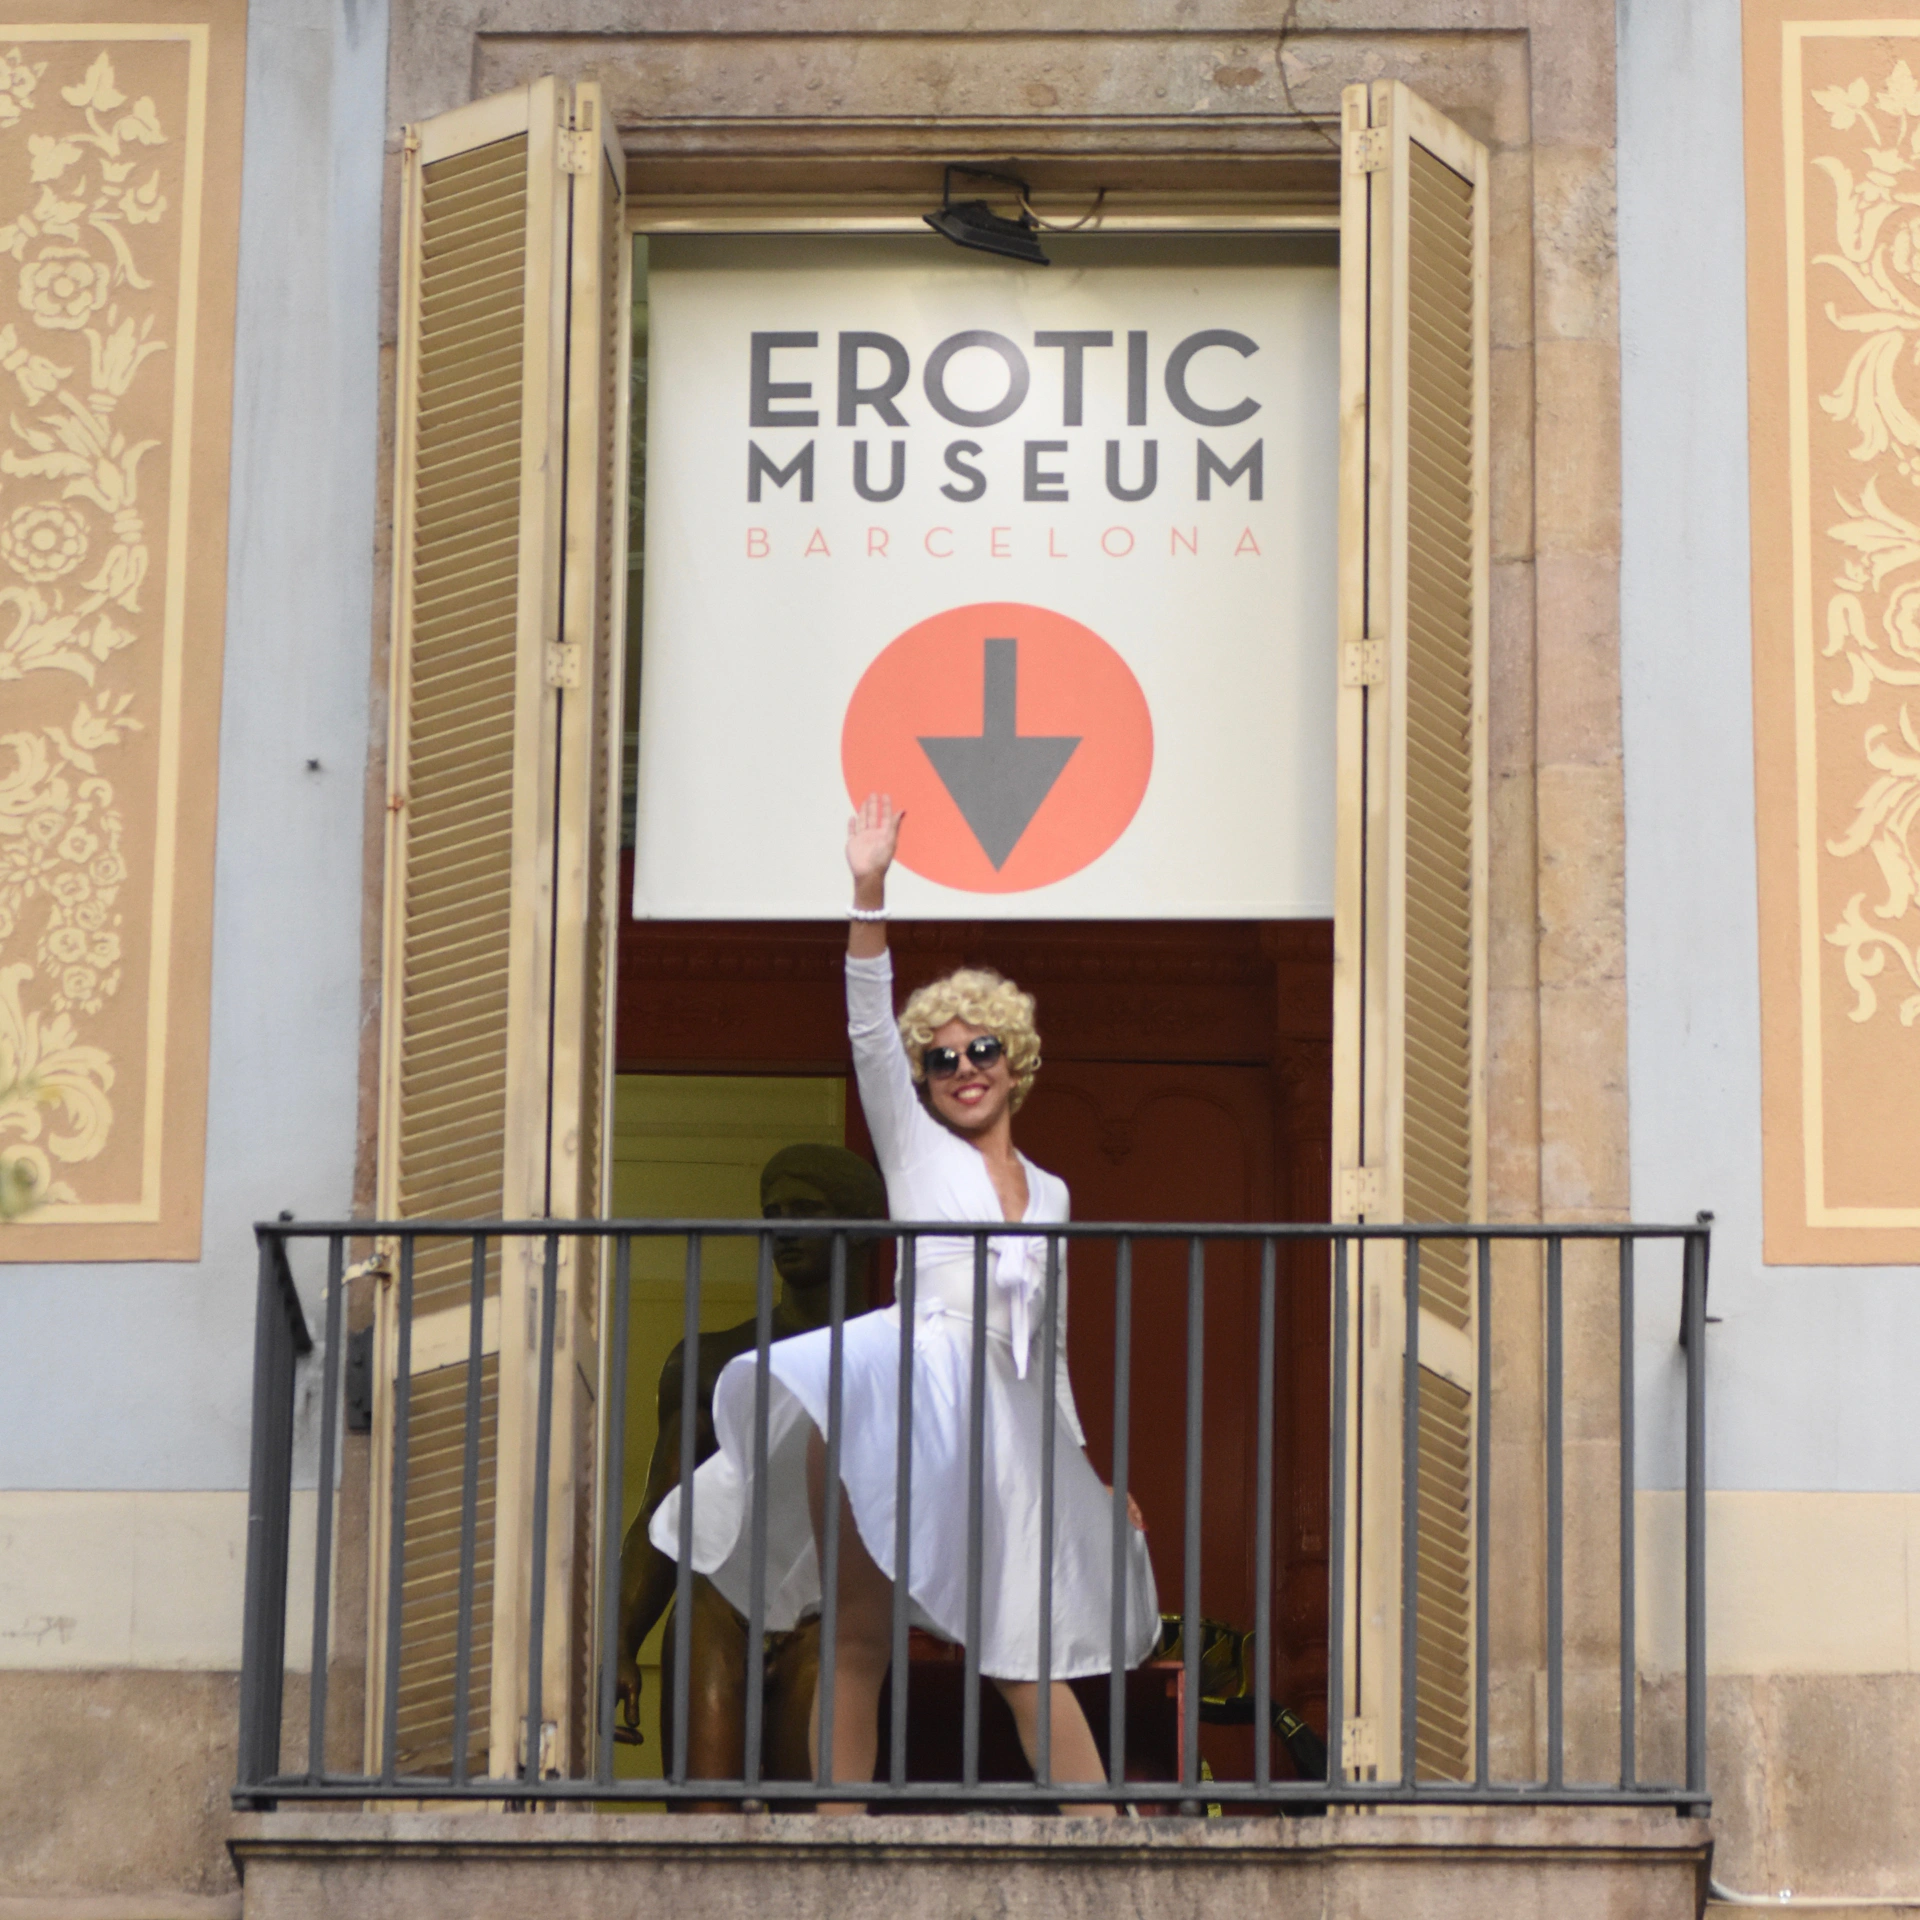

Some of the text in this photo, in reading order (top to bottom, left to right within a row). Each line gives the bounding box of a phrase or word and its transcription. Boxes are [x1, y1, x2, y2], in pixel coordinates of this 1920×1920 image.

[748, 329, 1262, 427] EROTIC
[748, 438, 1264, 502] MUSEUM
[746, 526, 1262, 558] BARCELONA
